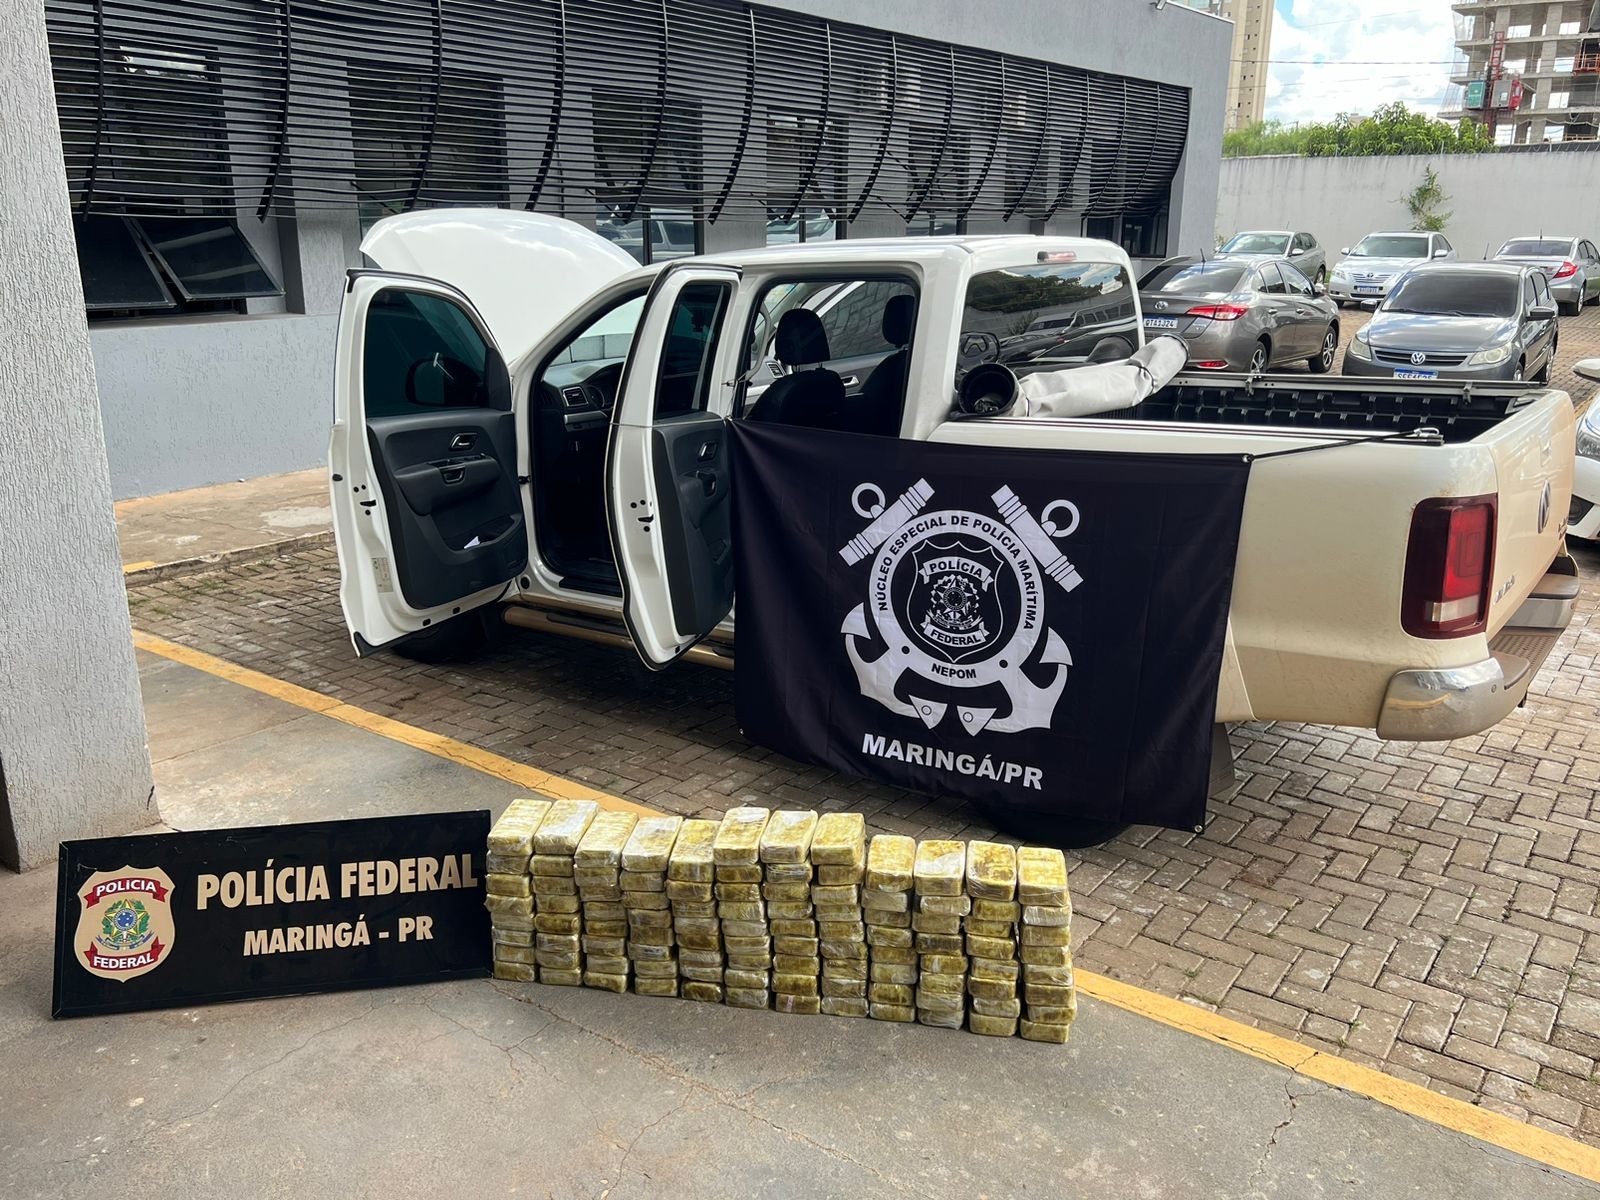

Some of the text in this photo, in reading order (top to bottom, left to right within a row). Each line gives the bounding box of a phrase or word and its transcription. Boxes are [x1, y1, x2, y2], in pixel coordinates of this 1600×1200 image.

[875, 515, 1037, 630] NÚCLEO ESPECIAL DE POLÍCIA MARÍTIMA
[929, 558, 983, 578] POLÍCIA
[930, 629, 981, 645] FEDERAL
[931, 662, 976, 679] NEPOM
[861, 733, 1044, 790] MARINGÁ/PR
[196, 853, 478, 910] POLÍCIA FEDERAL
[243, 914, 371, 957] MARINGÁ
[398, 915, 434, 943] PR
[93, 953, 154, 969] FEDERAL
